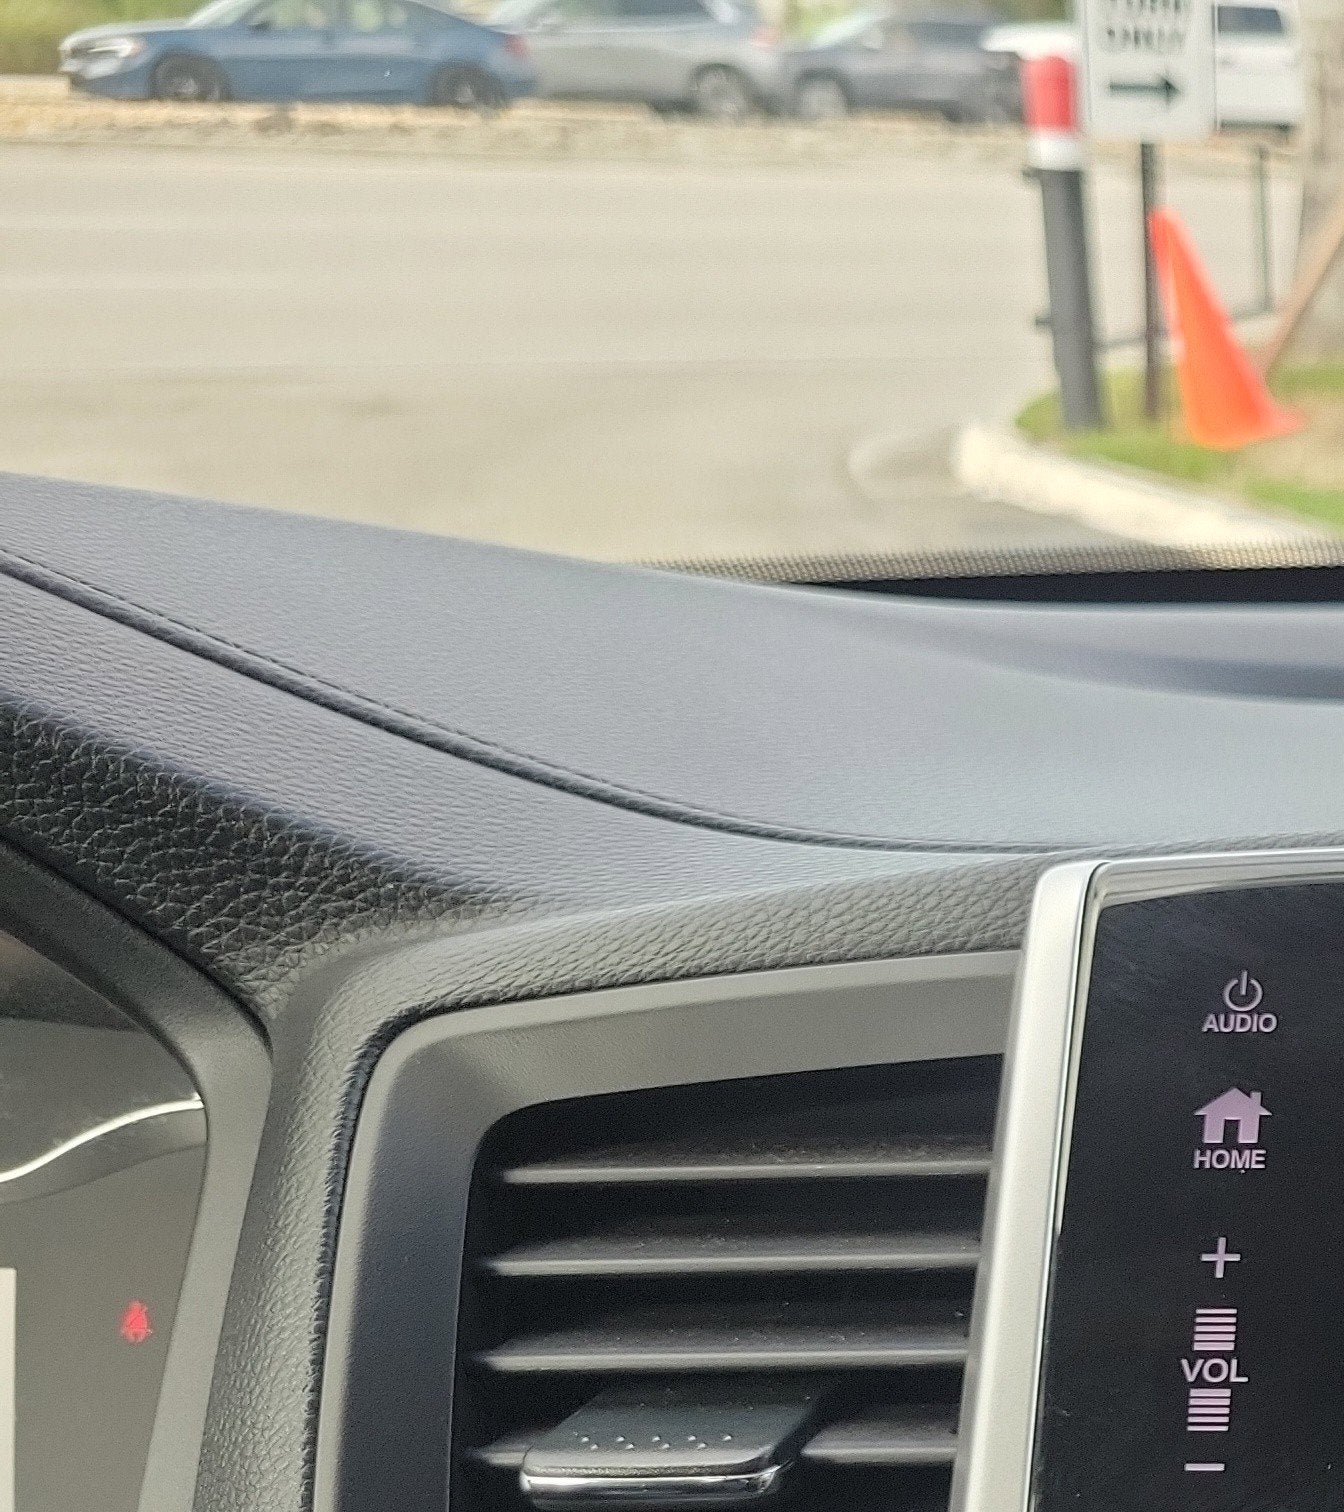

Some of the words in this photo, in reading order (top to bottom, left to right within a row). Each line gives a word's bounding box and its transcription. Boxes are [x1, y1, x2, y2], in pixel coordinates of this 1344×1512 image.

[1201, 1013, 1278, 1034] AUDIO
[1193, 1149, 1267, 1170] HOME
[1180, 1358, 1249, 1384] VOL
